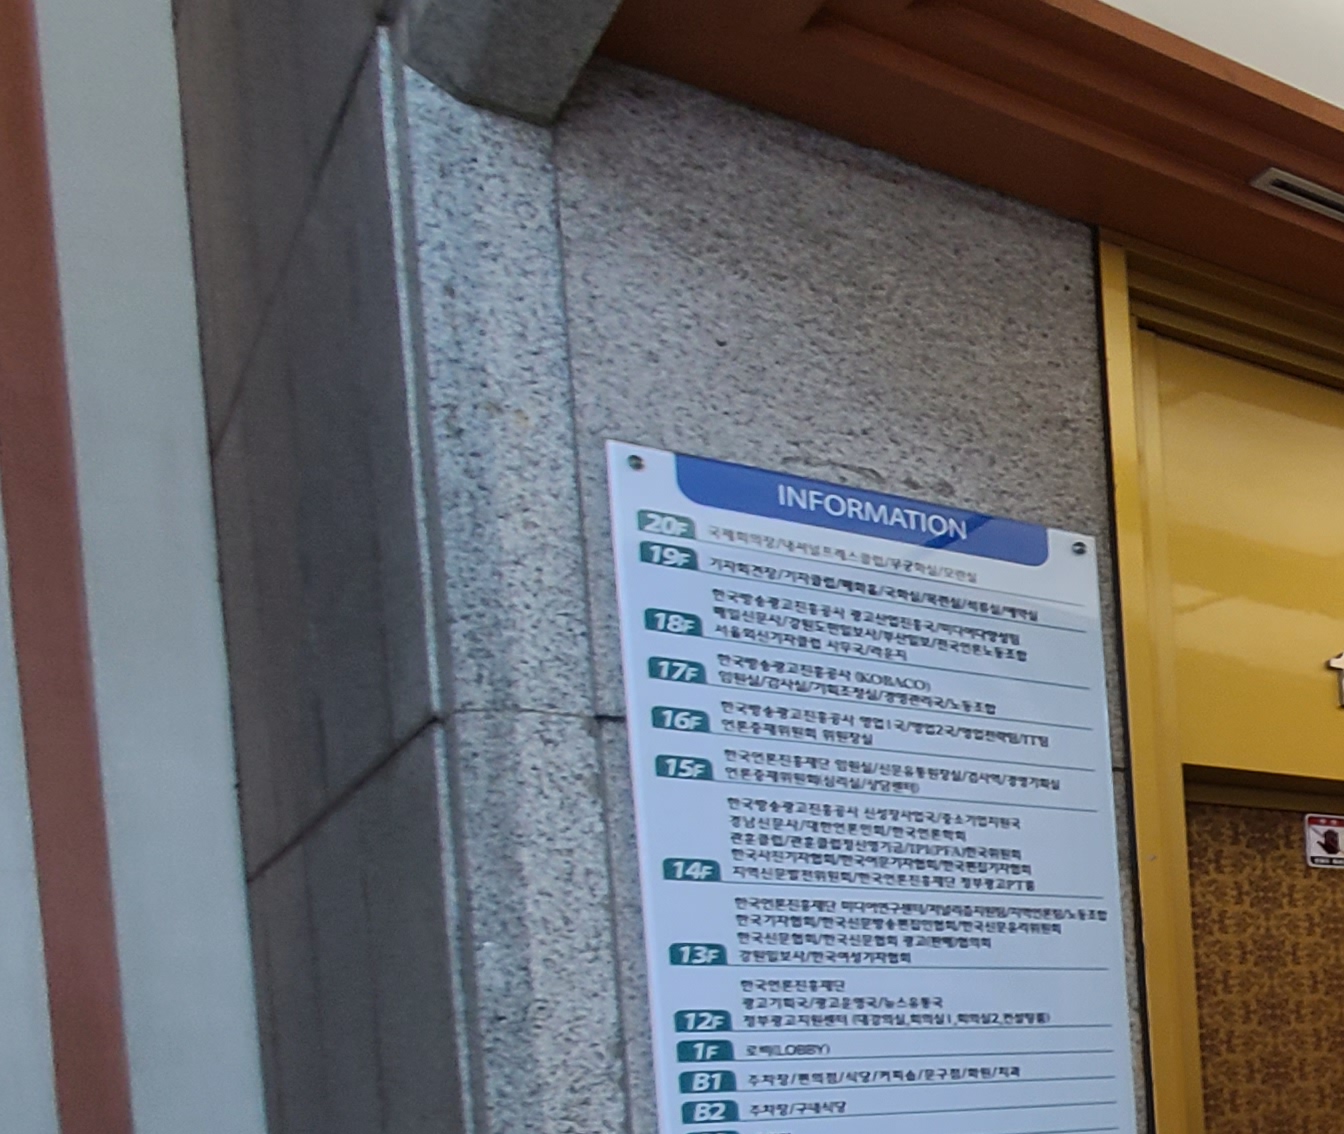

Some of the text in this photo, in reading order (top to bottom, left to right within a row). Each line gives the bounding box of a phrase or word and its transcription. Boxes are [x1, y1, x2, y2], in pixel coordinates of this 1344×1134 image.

[778, 484, 968, 540] INFORMATION
[644, 512, 689, 536] 20F
[649, 544, 691, 568] 19F
[712, 588, 845, 620] 한국방송광고진흥공사
[653, 612, 696, 634] 18F
[715, 624, 907, 661] 서울외신기자클럽 사무국/라운지
[658, 660, 699, 682] 17F
[717, 653, 931, 693] 한국방송광고진흥공사 (KOBACO)
[661, 709, 703, 730] 16F
[720, 700, 855, 727] 한국방송광고진흥공사
[721, 718, 873, 746] 언론중재위원회 위원장실
[665, 757, 706, 778] 15F
[724, 749, 830, 769] 한국언론진흥재단
[727, 797, 859, 819] 한국방송광고진흥공사
[672, 860, 713, 879] 14F
[734, 897, 836, 912] 한국언론진흥재단
[679, 946, 720, 964] 13F
[740, 979, 845, 993] 한국언론진흥재단
[684, 1013, 724, 1030] 12F
[743, 1014, 848, 1027] 정부광고지원센터
[693, 1043, 720, 1060] 1F
[746, 1043, 830, 1057] 로비(LOBBY)
[692, 1073, 721, 1091] B1
[694, 1104, 726, 1121] B2
[750, 1101, 847, 1116] 주차장/구내식당
